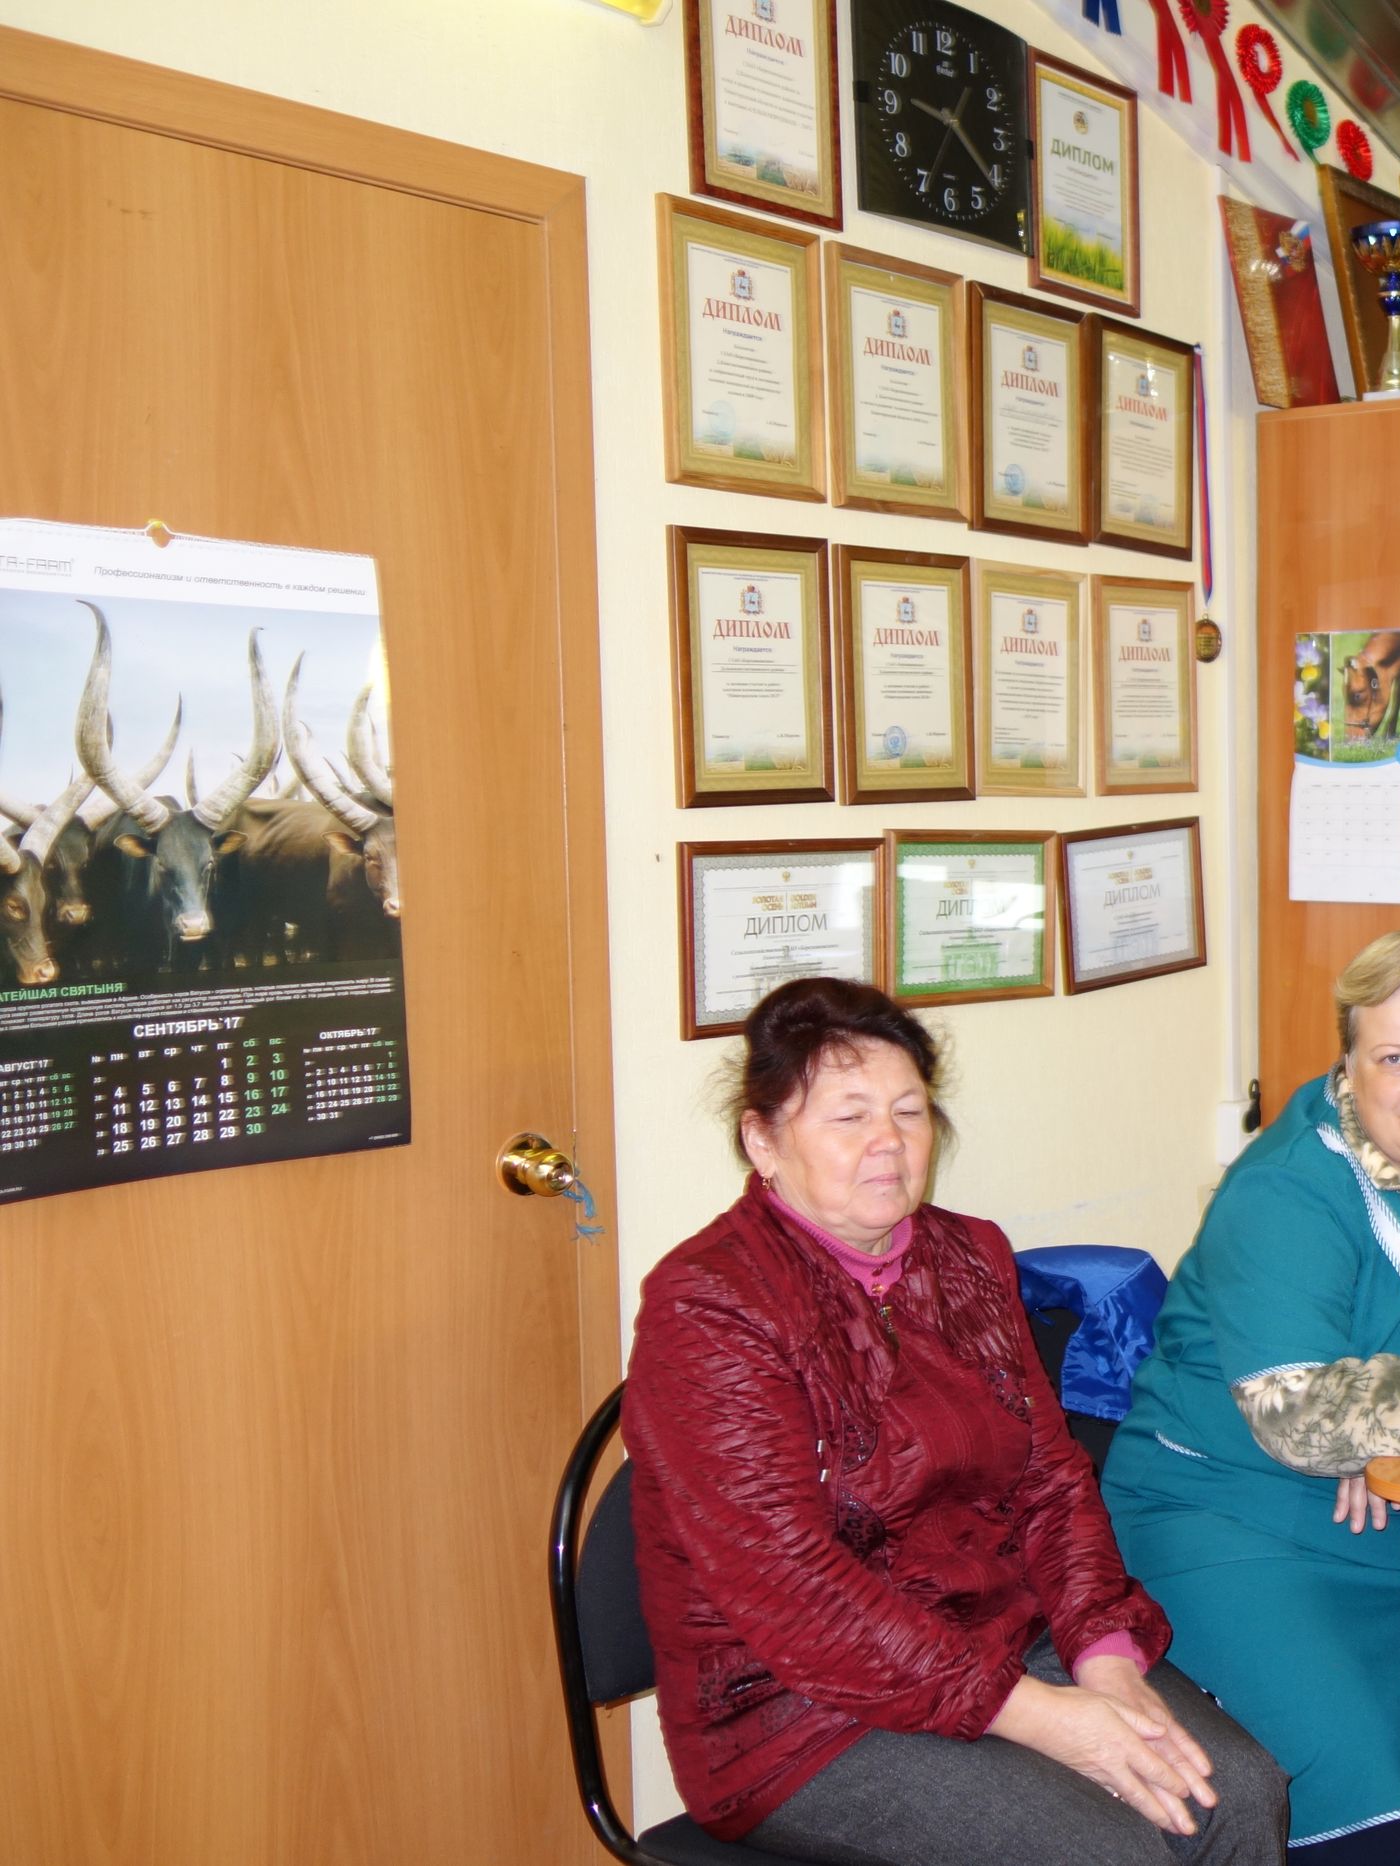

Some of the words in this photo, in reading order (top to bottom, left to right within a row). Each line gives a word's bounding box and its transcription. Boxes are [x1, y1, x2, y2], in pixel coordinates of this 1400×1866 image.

[725, 15, 804, 58] ДИПЛОМ
[912, 31, 925, 55] 11
[936, 31, 952, 55] 12
[890, 52, 907, 78] 10
[969, 53, 978, 74] 1
[884, 90, 897, 114] 9
[987, 88, 997, 111] 2
[895, 133, 907, 157] 8
[993, 128, 1005, 151] 3
[1051, 138, 1114, 175] ДИПЛОМ
[917, 168, 929, 192] 7
[991, 164, 1001, 189] 4
[944, 188, 955, 211] 6
[971, 186, 983, 209] 5
[703, 298, 782, 331] ДИПЛОМ
[863, 337, 931, 366] ДИПЛОМ
[1001, 370, 1058, 397] ДИПЛОМ
[1116, 396, 1168, 421] ДИПЛОМ
[713, 619, 791, 640] ДИПЛОМ
[873, 628, 939, 647] ДИПЛОМ
[1001, 636, 1058, 656] ДИПЛОМ
[1119, 645, 1170, 662] ДИПЛОМ
[1104, 884, 1160, 910] ДИПЛОМ
[744, 913, 827, 940] ДИПЛОМ
[61, 982, 123, 997] СВЯТЫНЯ
[111, 1053, 123, 1061] пн
[164, 1047, 177, 1056] ср
[191, 1044, 202, 1052] чт
[217, 1042, 228, 1050] пт
[243, 1038, 255, 1047] сб
[221, 1058, 228, 1068] 1
[246, 1055, 255, 1066] 2
[273, 1053, 280, 1063] 3
[115, 1087, 122, 1098] 4
[142, 1084, 151, 1095] 5
[168, 1081, 176, 1092] 6
[194, 1078, 202, 1089] 7
[221, 1075, 229, 1086] 8
[247, 1072, 255, 1083] 9
[270, 1069, 285, 1080] 10
[2, 1105, 7, 1113] 8
[113, 1104, 126, 1116] 11
[139, 1100, 153, 1112] 12
[165, 1098, 180, 1110] 13
[192, 1095, 206, 1106] 14
[218, 1093, 233, 1104] 15
[244, 1089, 259, 1101] 16
[271, 1086, 285, 1098] 17
[39, 1125, 49, 1133] 25
[52, 1123, 61, 1131] 26
[113, 1123, 127, 1134] 18
[140, 1119, 155, 1131] 19
[166, 1116, 181, 1128] 20
[193, 1113, 208, 1124] 21
[219, 1109, 234, 1121] 22
[245, 1106, 260, 1118] 23
[271, 1104, 287, 1115] 24
[2, 1143, 11, 1151] 29
[113, 1141, 128, 1153] 25
[141, 1137, 156, 1149] 26
[166, 1133, 182, 1145] 27
[193, 1130, 208, 1142] 28
[220, 1127, 235, 1139] 29
[246, 1123, 262, 1135] 30
